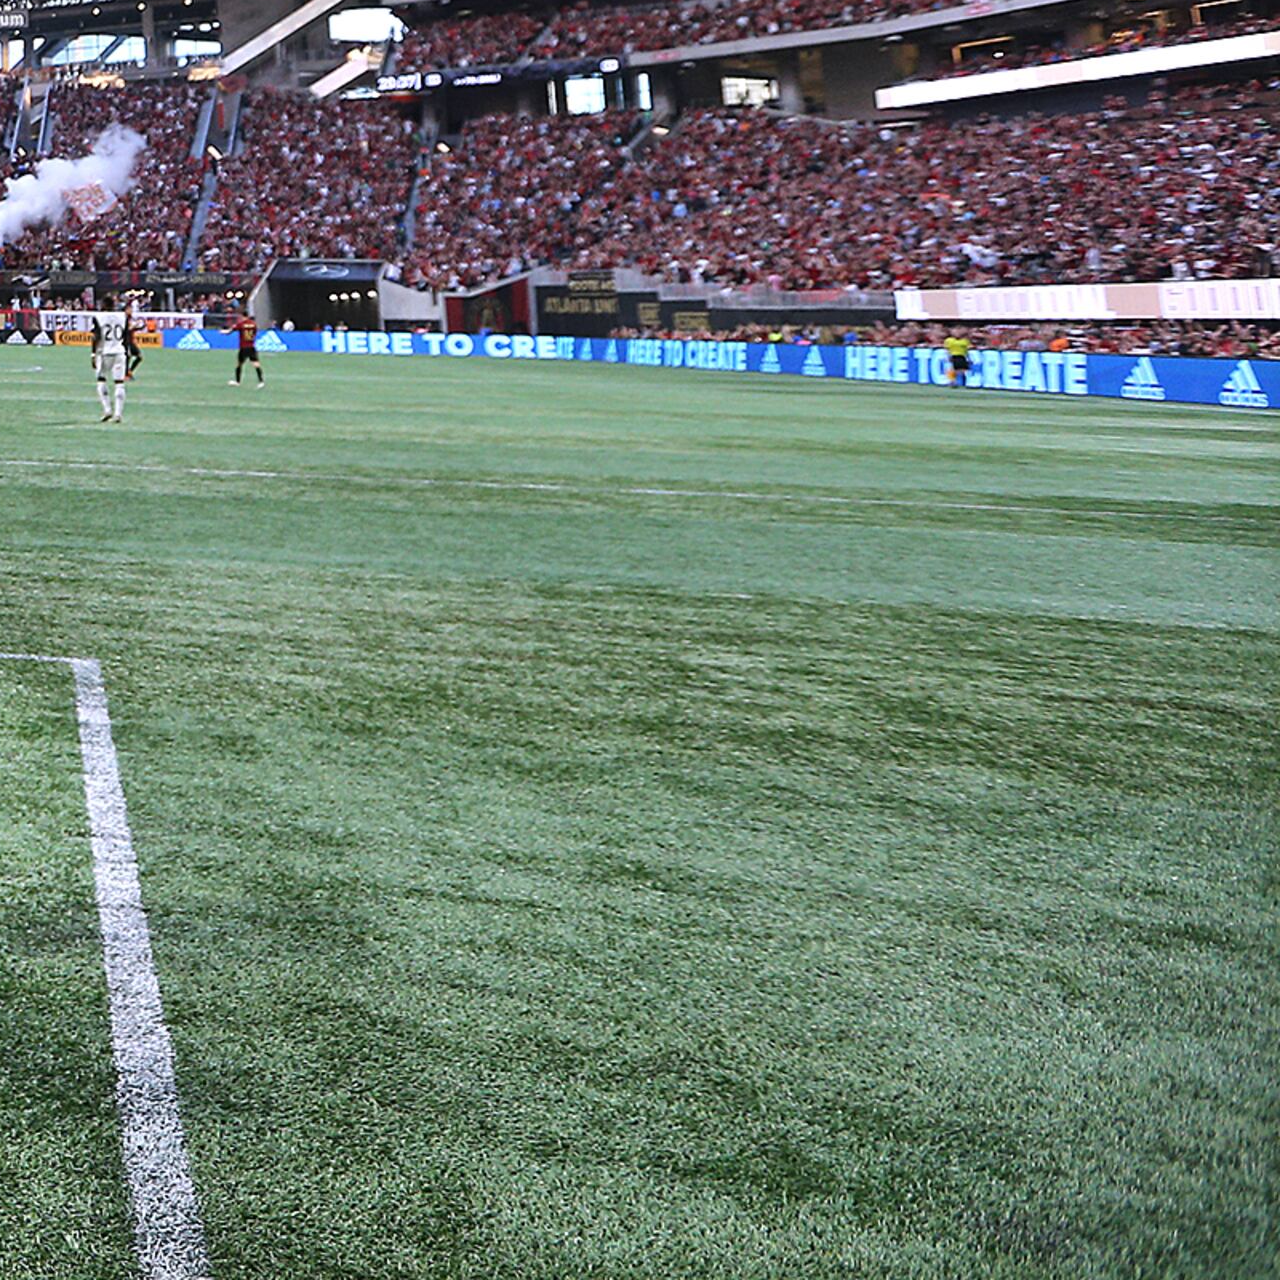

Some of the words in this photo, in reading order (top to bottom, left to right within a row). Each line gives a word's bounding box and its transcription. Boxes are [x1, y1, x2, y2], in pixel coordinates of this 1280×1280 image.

[58, 332, 95, 344] Contin
[104, 323, 125, 341] 20
[322, 328, 414, 355] HERE
[425, 331, 474, 358] TO
[483, 334, 575, 361] CREATE
[627, 339, 661, 366] HERE
[663, 340, 684, 368] TO
[686, 340, 747, 371] CREATE
[845, 345, 910, 382] HERE
[914, 347, 950, 385] TO
[966, 350, 1089, 395] CREATE
